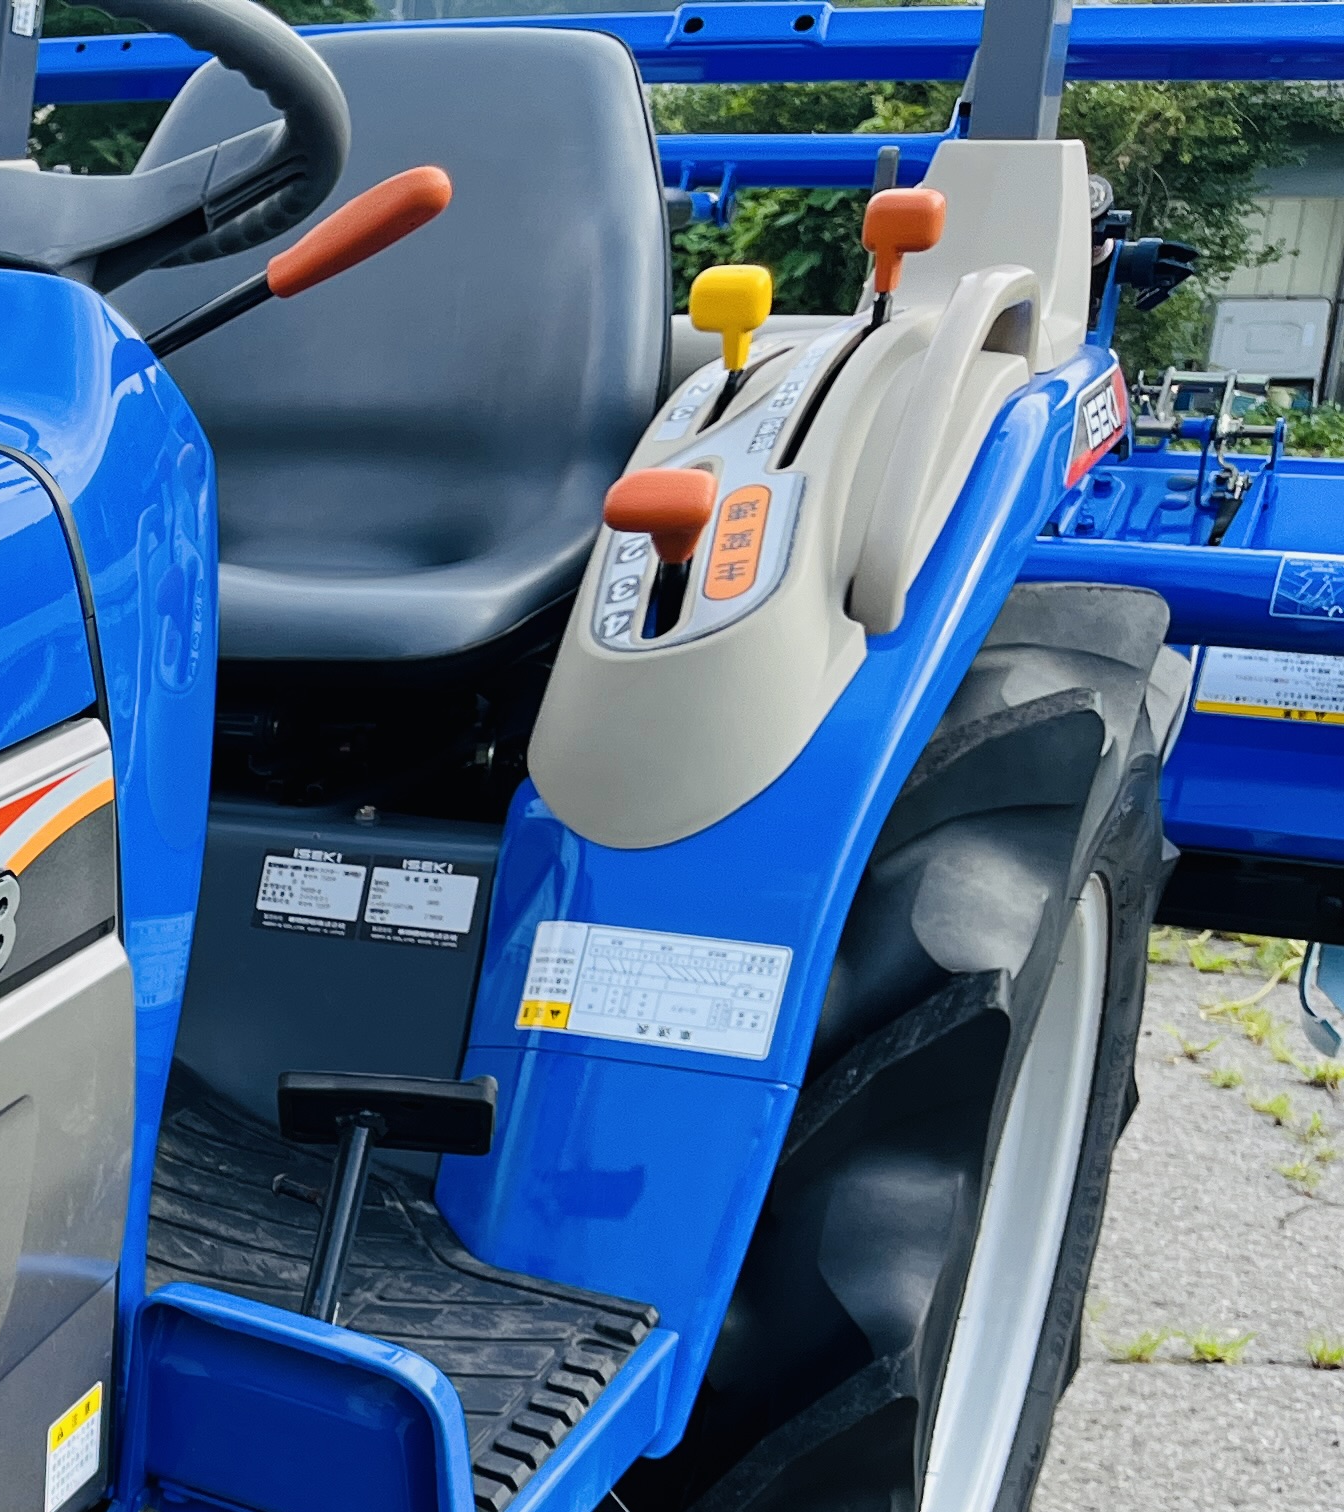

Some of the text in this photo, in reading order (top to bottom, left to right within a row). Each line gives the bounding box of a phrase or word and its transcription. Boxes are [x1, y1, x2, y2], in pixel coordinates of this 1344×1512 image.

[1082, 385, 1122, 450] ISEKI
[615, 536, 650, 564] 2
[605, 575, 641, 604] 3
[598, 609, 635, 640] 4
[293, 847, 343, 864] ISEKI
[402, 858, 454, 875] ISEKI
